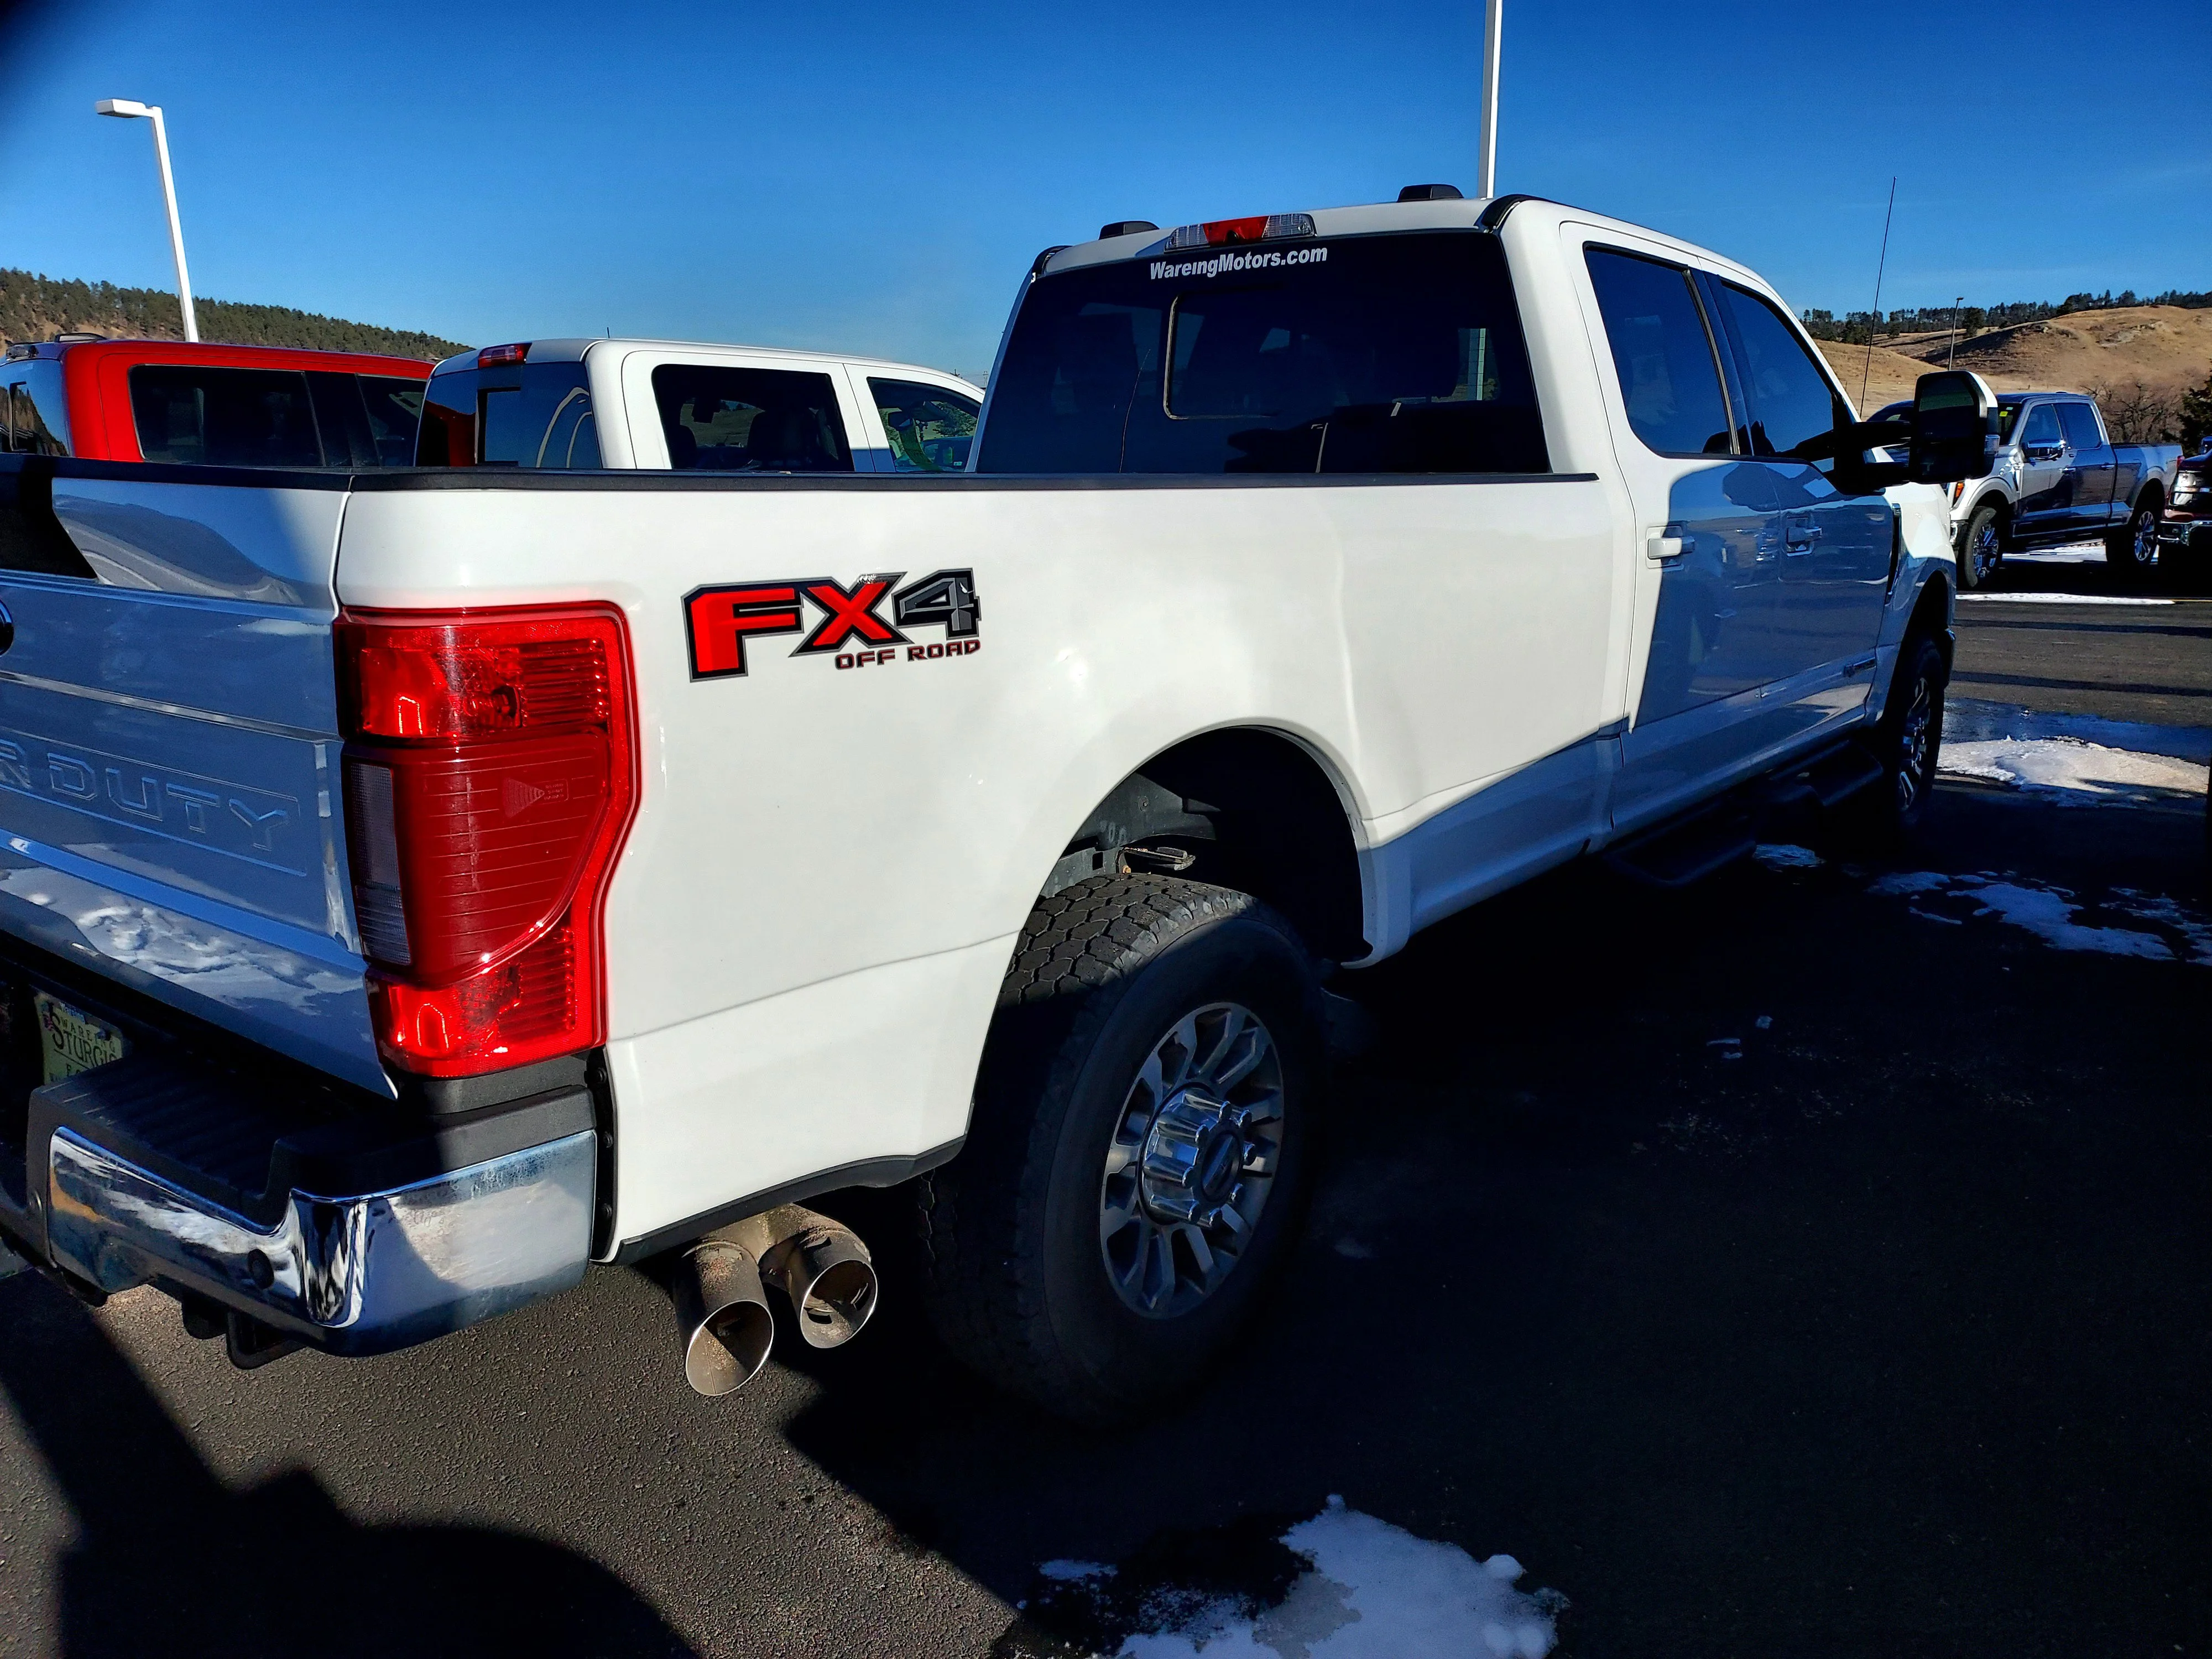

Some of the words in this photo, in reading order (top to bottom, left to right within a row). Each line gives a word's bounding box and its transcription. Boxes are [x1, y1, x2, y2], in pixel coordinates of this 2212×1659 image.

[1150, 247, 1328, 280] WareingMotors.com
[680, 567, 982, 682] FX4
[834, 649, 896, 670] OFF
[907, 639, 982, 662] ROAD
[47, 752, 290, 852] DUTY
